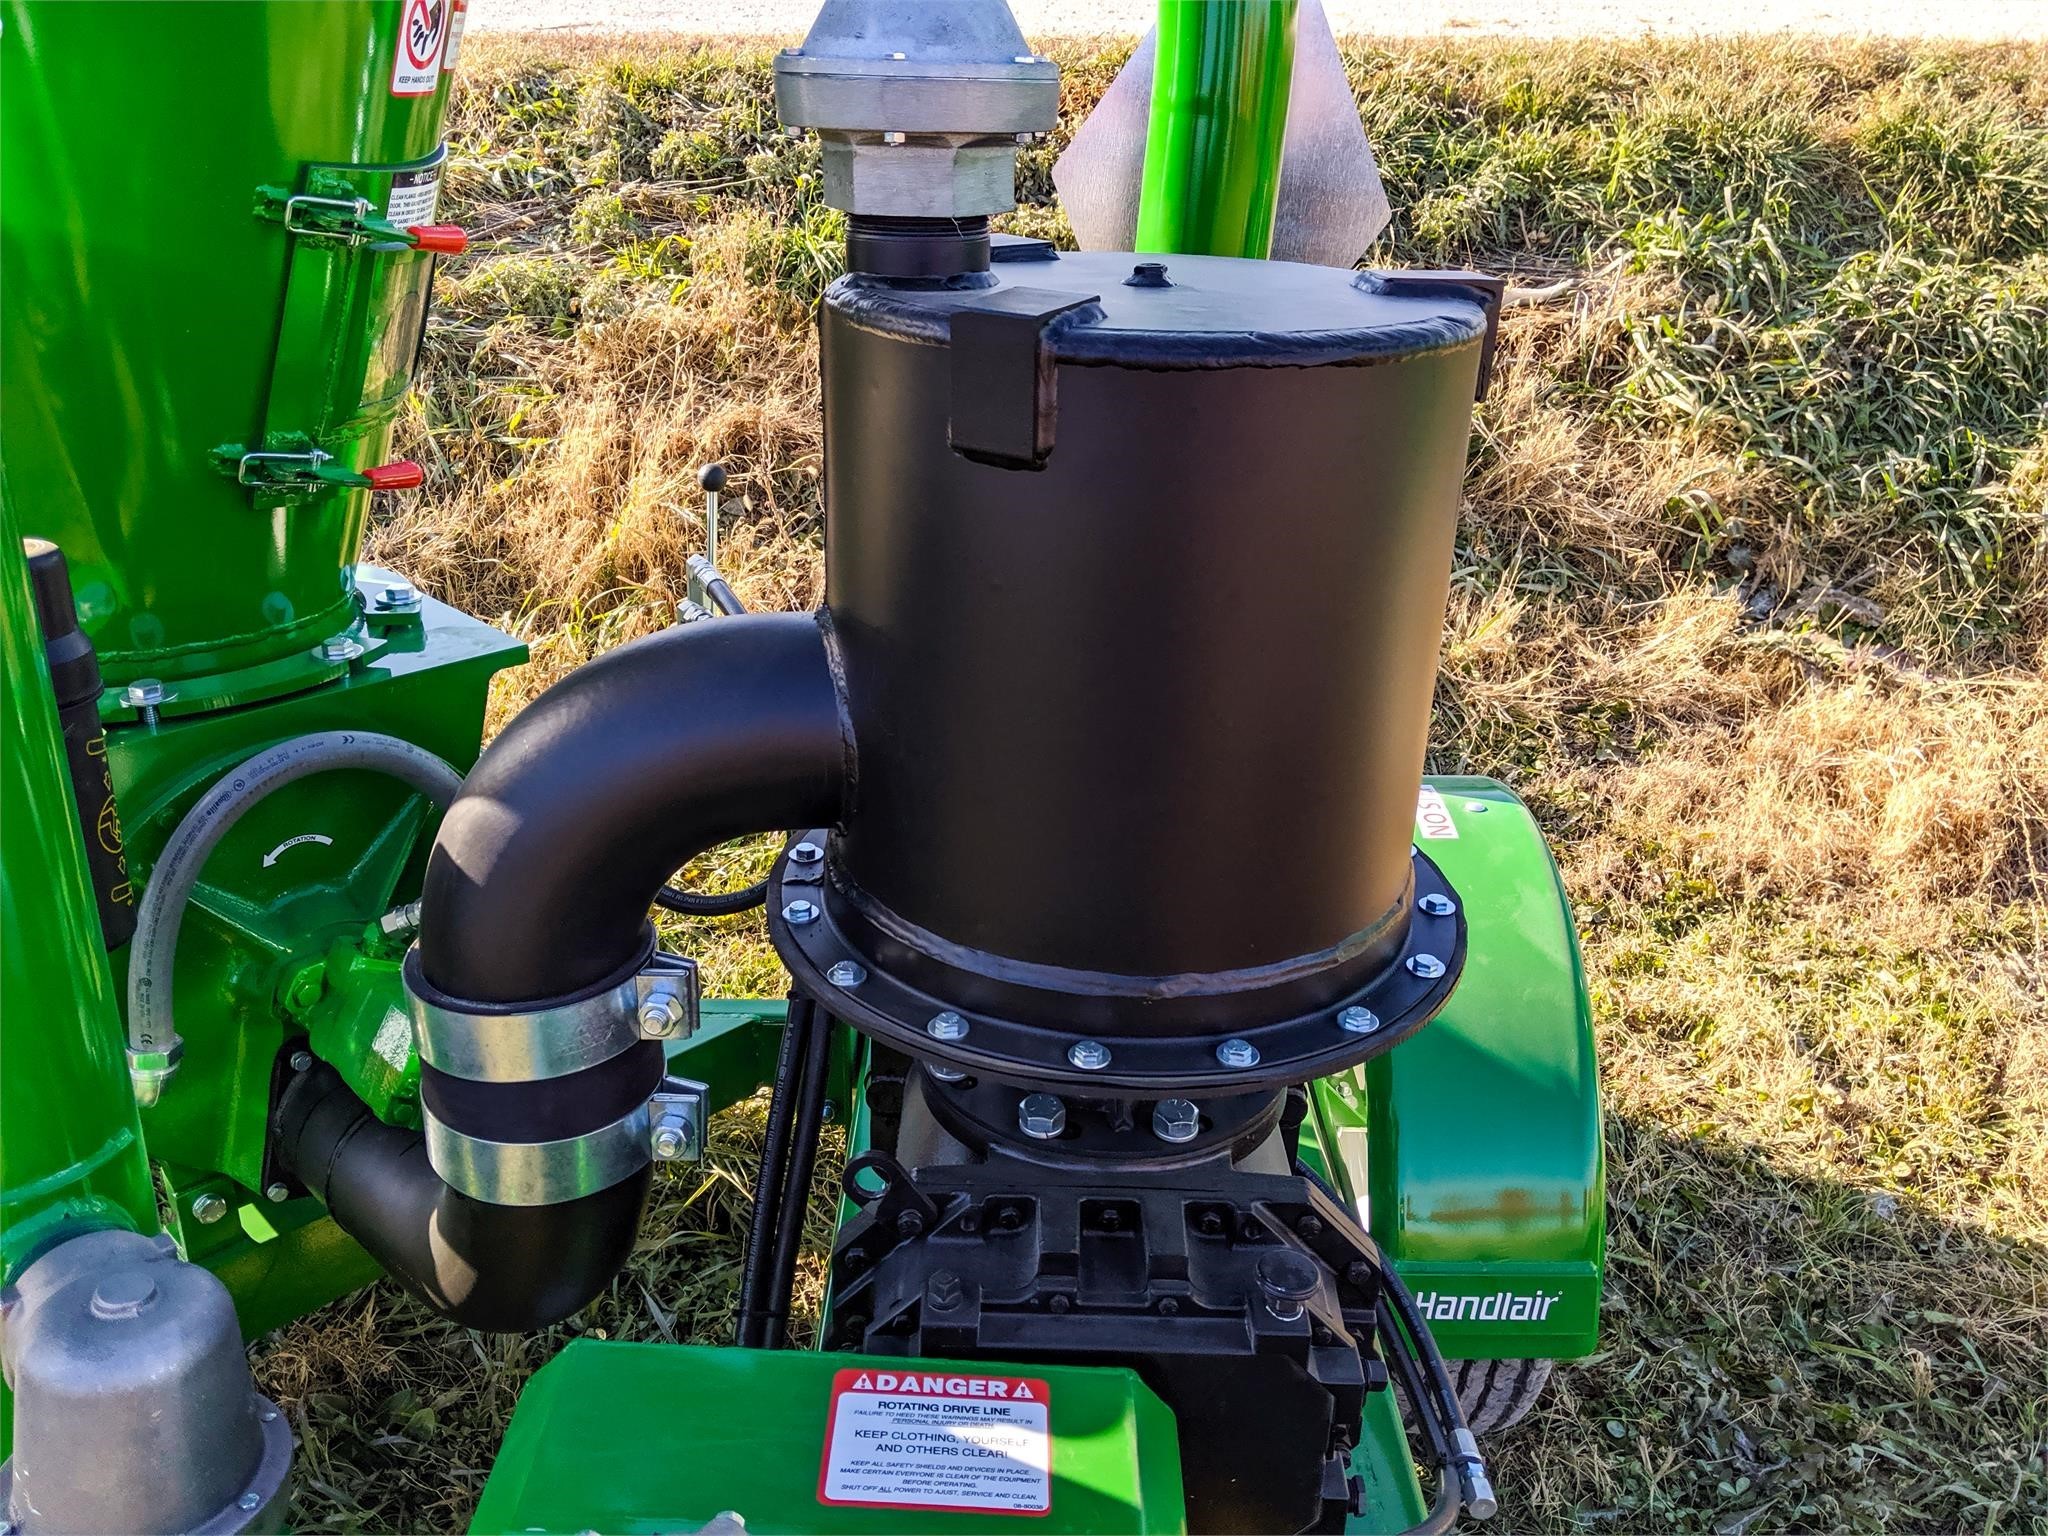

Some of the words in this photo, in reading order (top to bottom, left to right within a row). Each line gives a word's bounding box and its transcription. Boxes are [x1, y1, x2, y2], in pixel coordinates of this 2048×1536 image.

[283, 835, 317, 848] ROTATION
[1416, 1290, 1559, 1321] Handlair
[876, 1374, 1008, 1398] DANGER
[878, 1401, 940, 1412] ROTATING
[943, 1404, 981, 1415] DRIVE
[983, 1407, 1011, 1416] LINE
[941, 1414, 979, 1422] WARNINGS
[854, 1429, 888, 1439] KEEP
[891, 1431, 960, 1444] CLOTHING,
[963, 1435, 1030, 1447] YOURSELF
[875, 1444, 902, 1453] AND
[906, 1445, 959, 1456] OTHERS
[961, 1448, 1009, 1459] CLEAR!
[895, 1470, 936, 1478] EVERYONE
[998, 1476, 1043, 1484] EQUIPMENT
[964, 1466, 996, 1474] DEVICES
[961, 1490, 994, 1498] SERVICE
